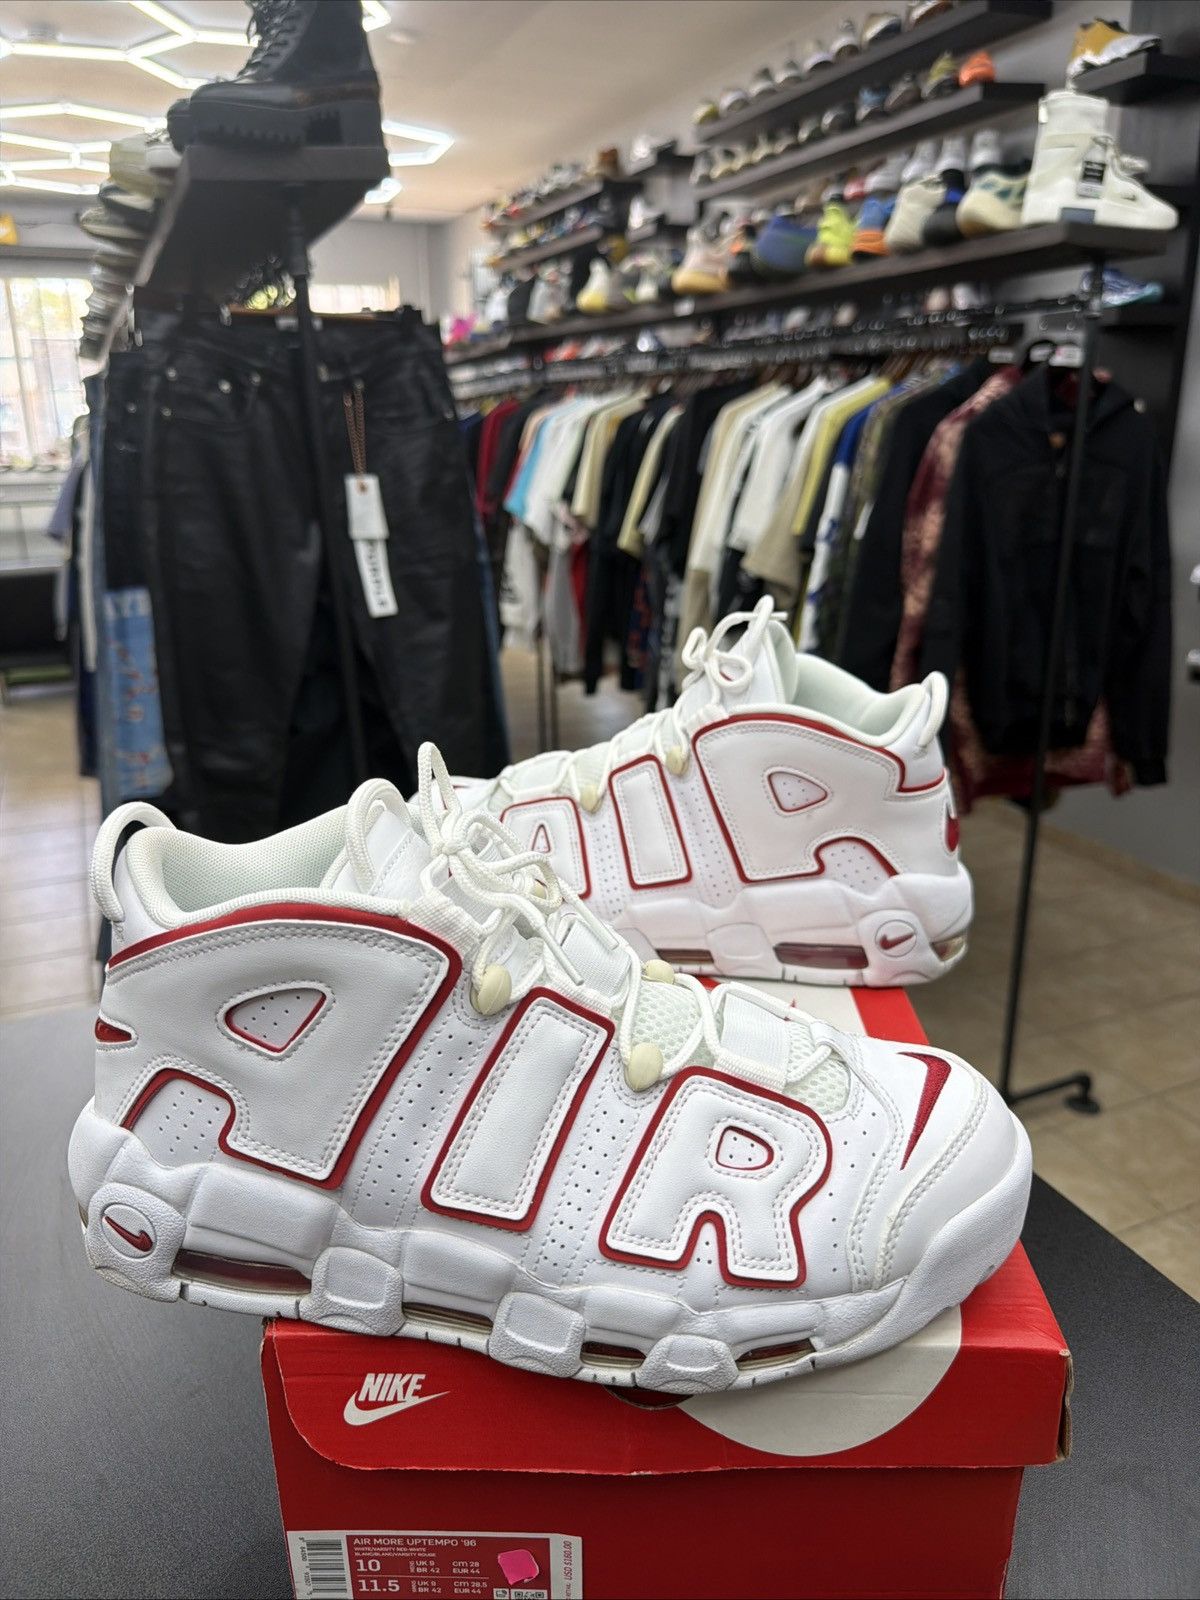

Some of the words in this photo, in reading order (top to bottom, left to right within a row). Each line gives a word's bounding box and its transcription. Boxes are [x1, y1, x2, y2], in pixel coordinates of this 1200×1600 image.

[358, 1373, 426, 1402] NIKE
[353, 1538, 371, 1546] AIR
[373, 1538, 404, 1546] MORE
[406, 1539, 459, 1547] UPTEMPO
[563, 1540, 573, 1566] $160.00
[355, 1559, 381, 1572] 10
[563, 1566, 573, 1580] USD
[358, 1580, 400, 1592] 11.5
